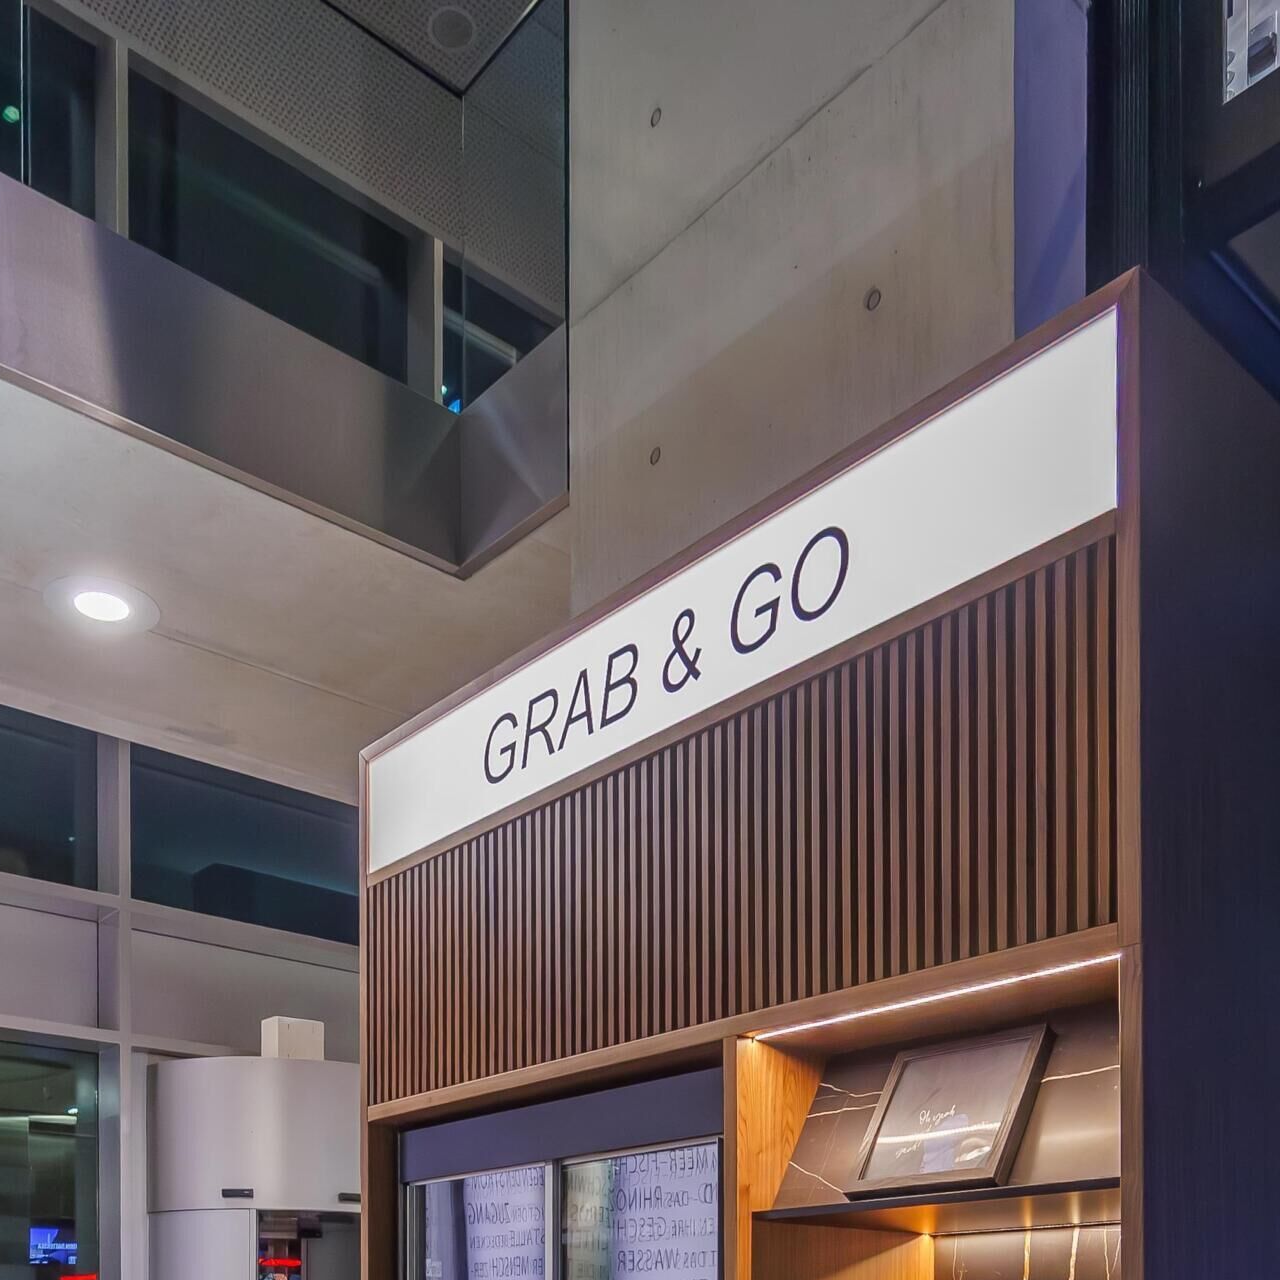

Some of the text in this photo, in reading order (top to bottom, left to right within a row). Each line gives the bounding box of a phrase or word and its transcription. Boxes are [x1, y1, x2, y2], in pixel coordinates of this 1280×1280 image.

[483, 526, 850, 785] GRAB & GO
